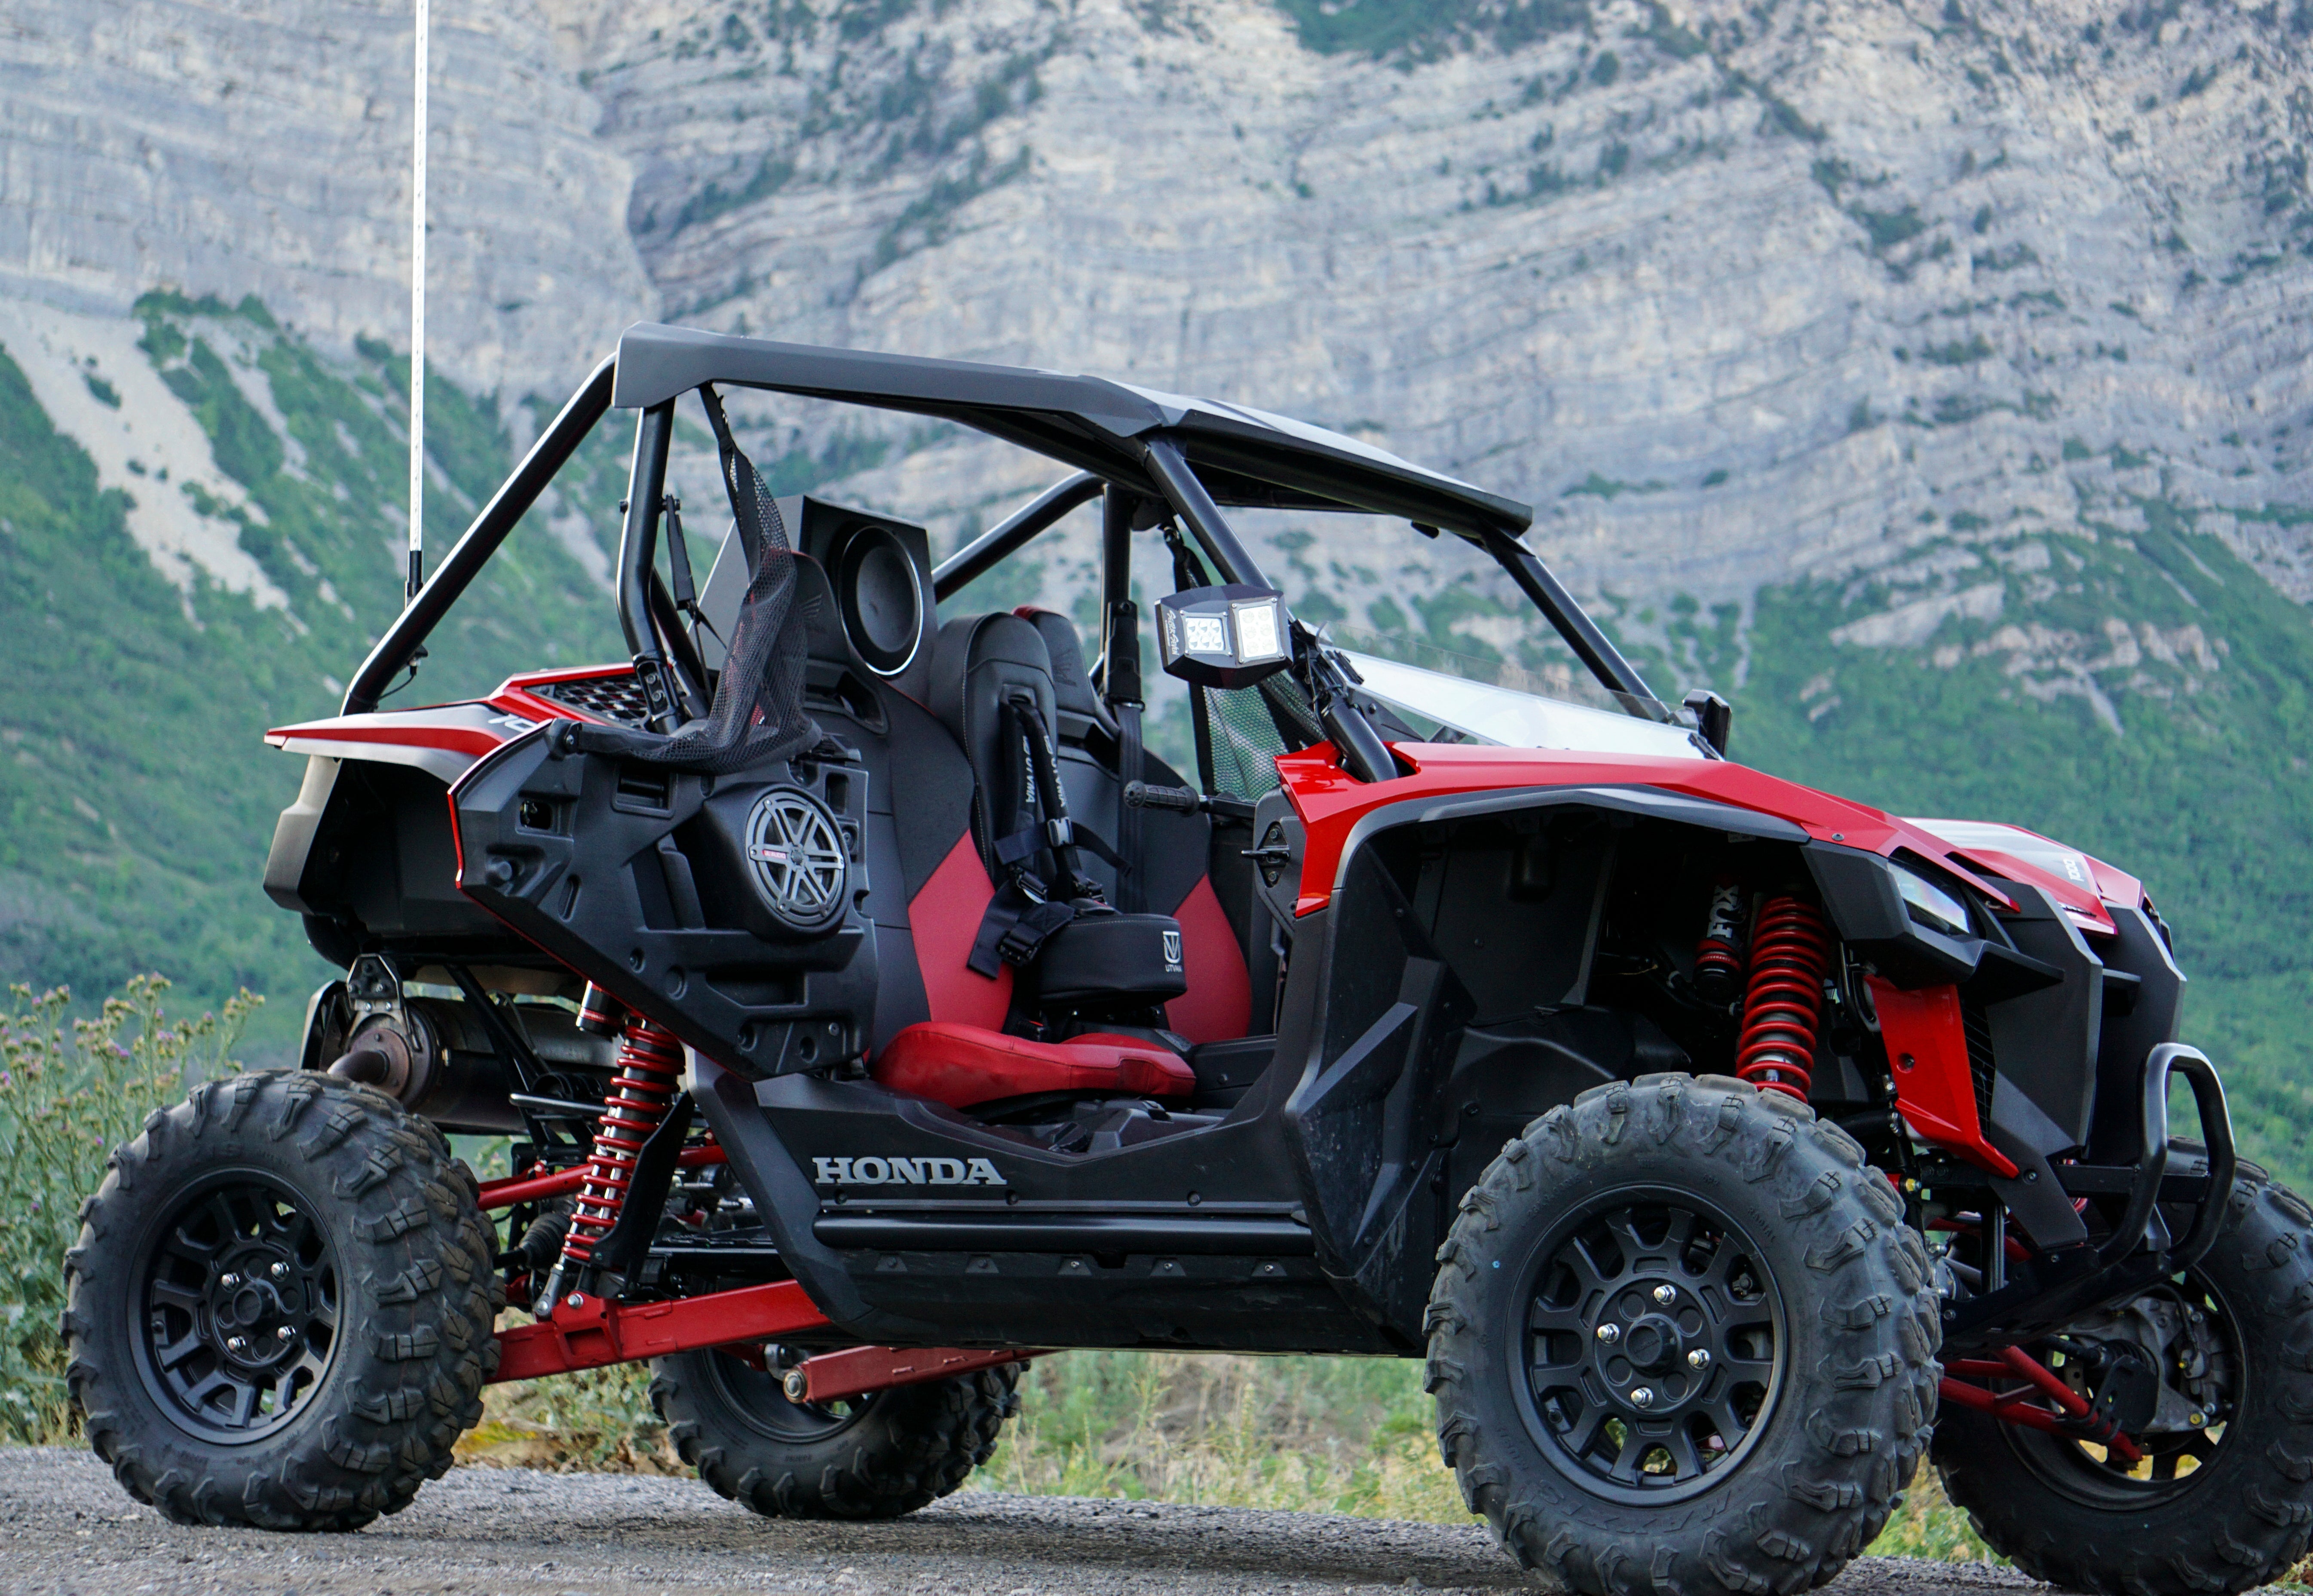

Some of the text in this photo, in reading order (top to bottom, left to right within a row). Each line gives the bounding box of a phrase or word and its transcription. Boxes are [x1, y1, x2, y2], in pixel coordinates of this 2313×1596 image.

[487, 713, 537, 732] 10
[2063, 859, 2085, 882] 1000
[1706, 884, 1741, 939] FOX
[812, 1157, 1007, 1185] HONDA
